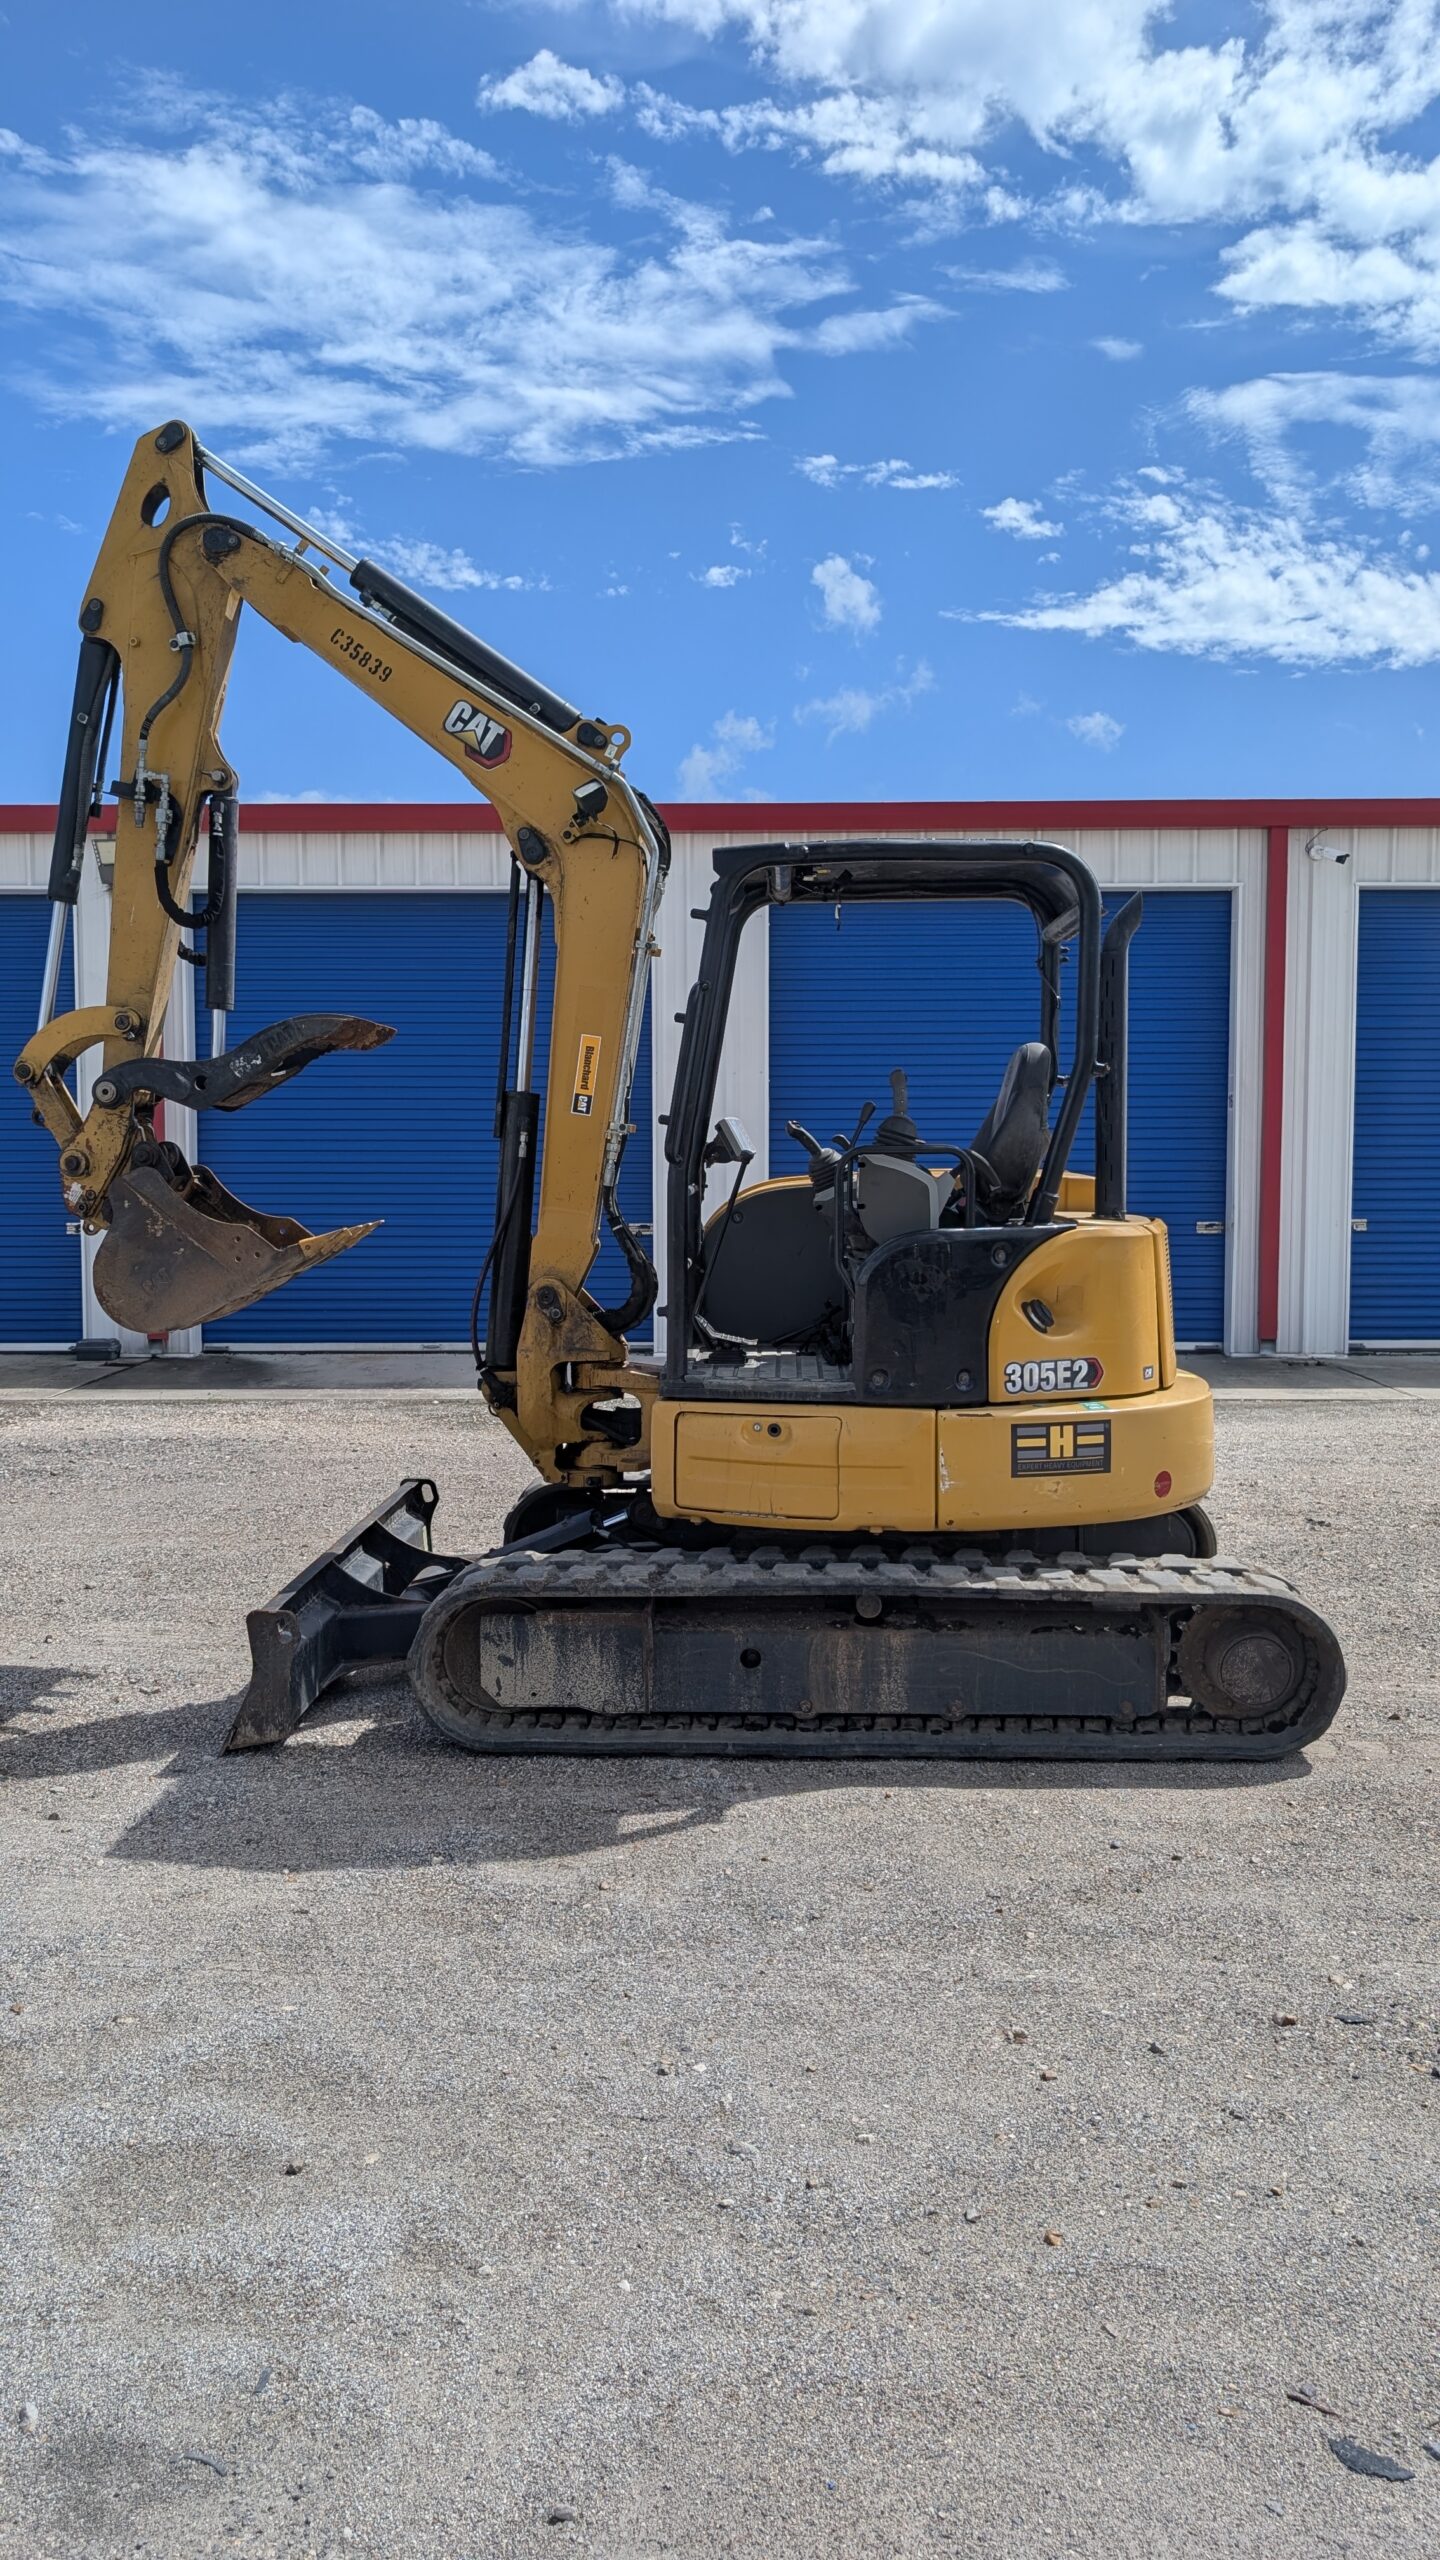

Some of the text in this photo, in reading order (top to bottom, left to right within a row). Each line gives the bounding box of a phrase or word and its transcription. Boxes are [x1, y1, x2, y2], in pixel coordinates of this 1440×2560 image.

[330, 628, 393, 682] C35839
[445, 701, 506, 755] CAT
[577, 1045, 595, 1113] Blanchard CAT
[1005, 1359, 1089, 1393] 305E2
[1017, 1460, 1104, 1471] EXPERT HEAVY EQUIPMENT
